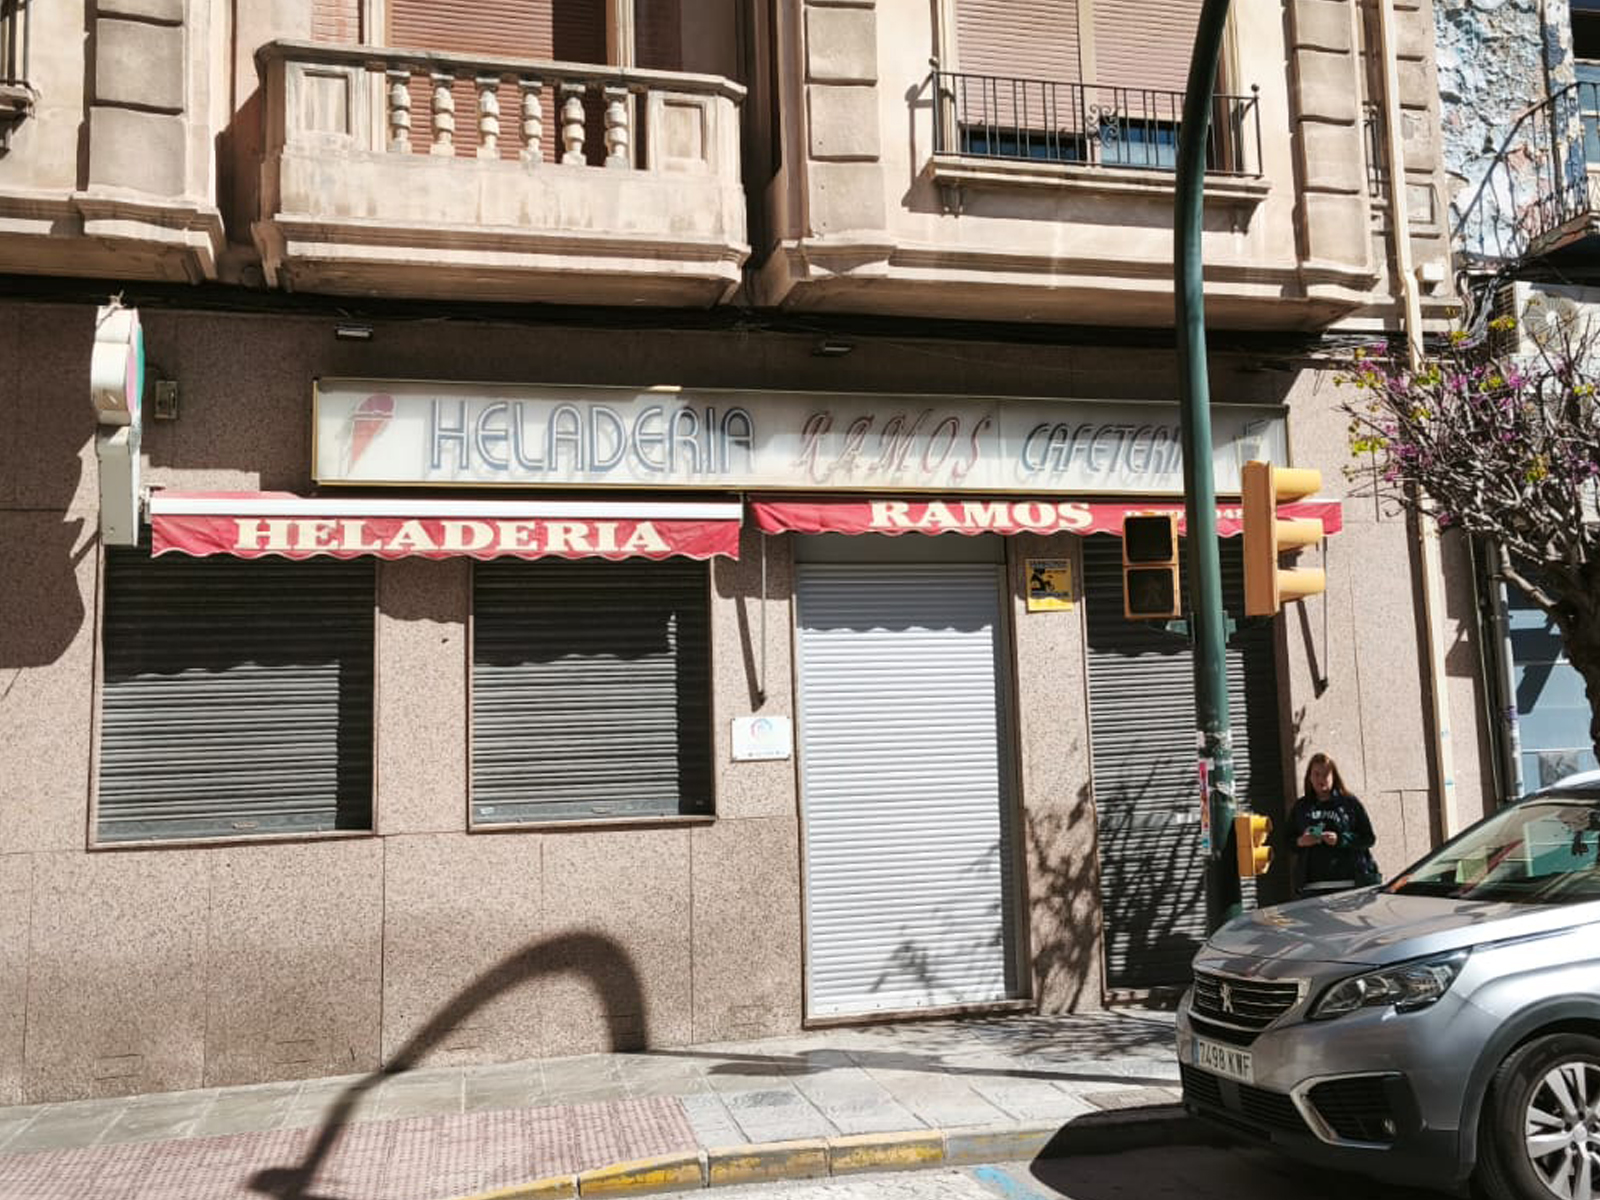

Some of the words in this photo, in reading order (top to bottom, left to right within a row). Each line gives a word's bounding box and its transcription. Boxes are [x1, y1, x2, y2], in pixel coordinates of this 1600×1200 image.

[431, 399, 754, 473] HELADERIA
[794, 408, 992, 484] RAMOS
[1022, 422, 1183, 473] CAFETERI
[869, 500, 1093, 529] RAMOS
[233, 518, 671, 552] HELADERIA
